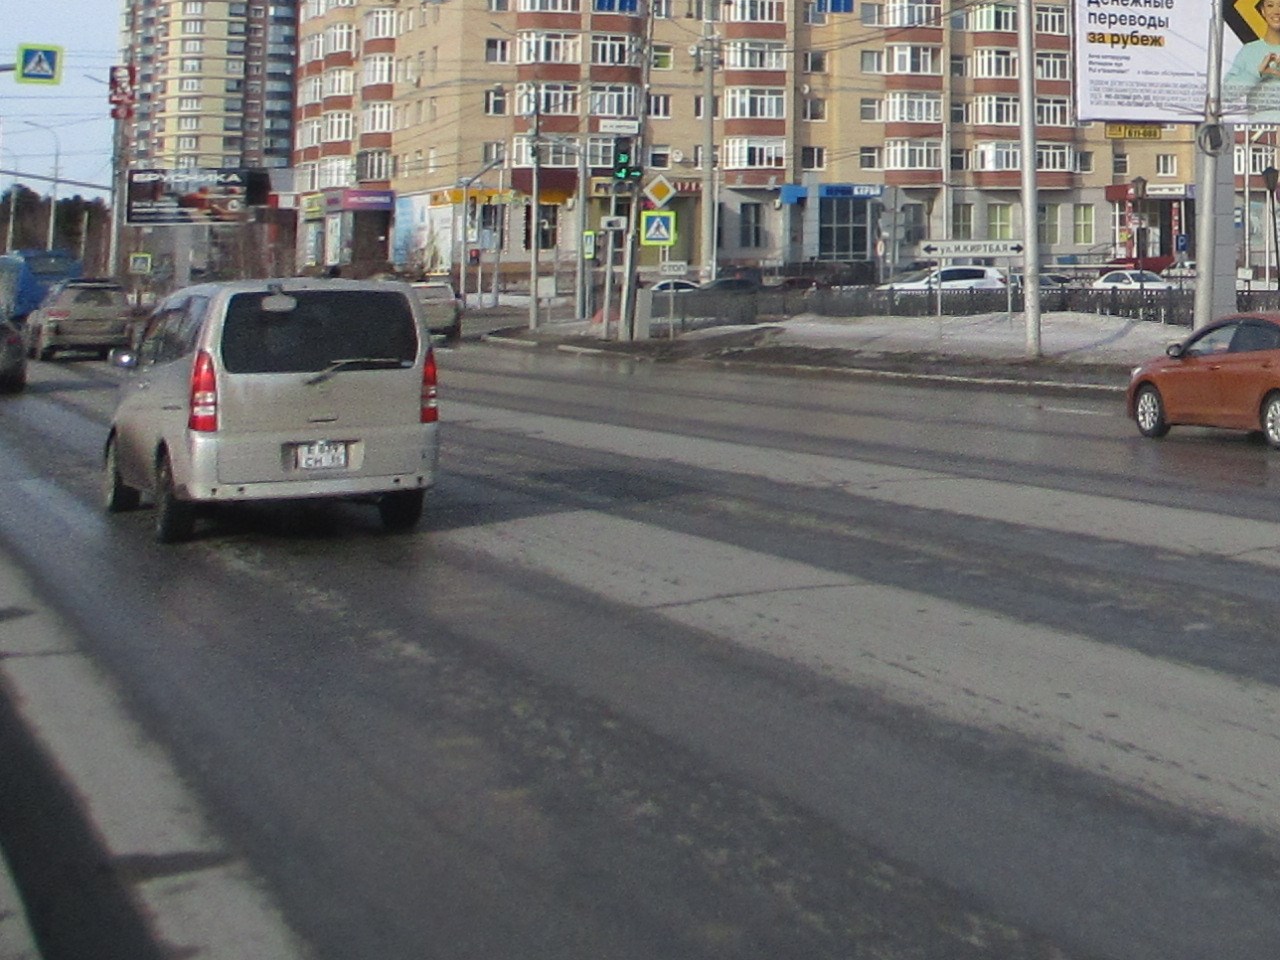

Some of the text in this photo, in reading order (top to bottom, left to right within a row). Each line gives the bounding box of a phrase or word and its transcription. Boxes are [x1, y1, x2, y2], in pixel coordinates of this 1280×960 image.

[1087, 11, 1169, 29] переводы
[1087, 30, 1162, 50] за рубеж
